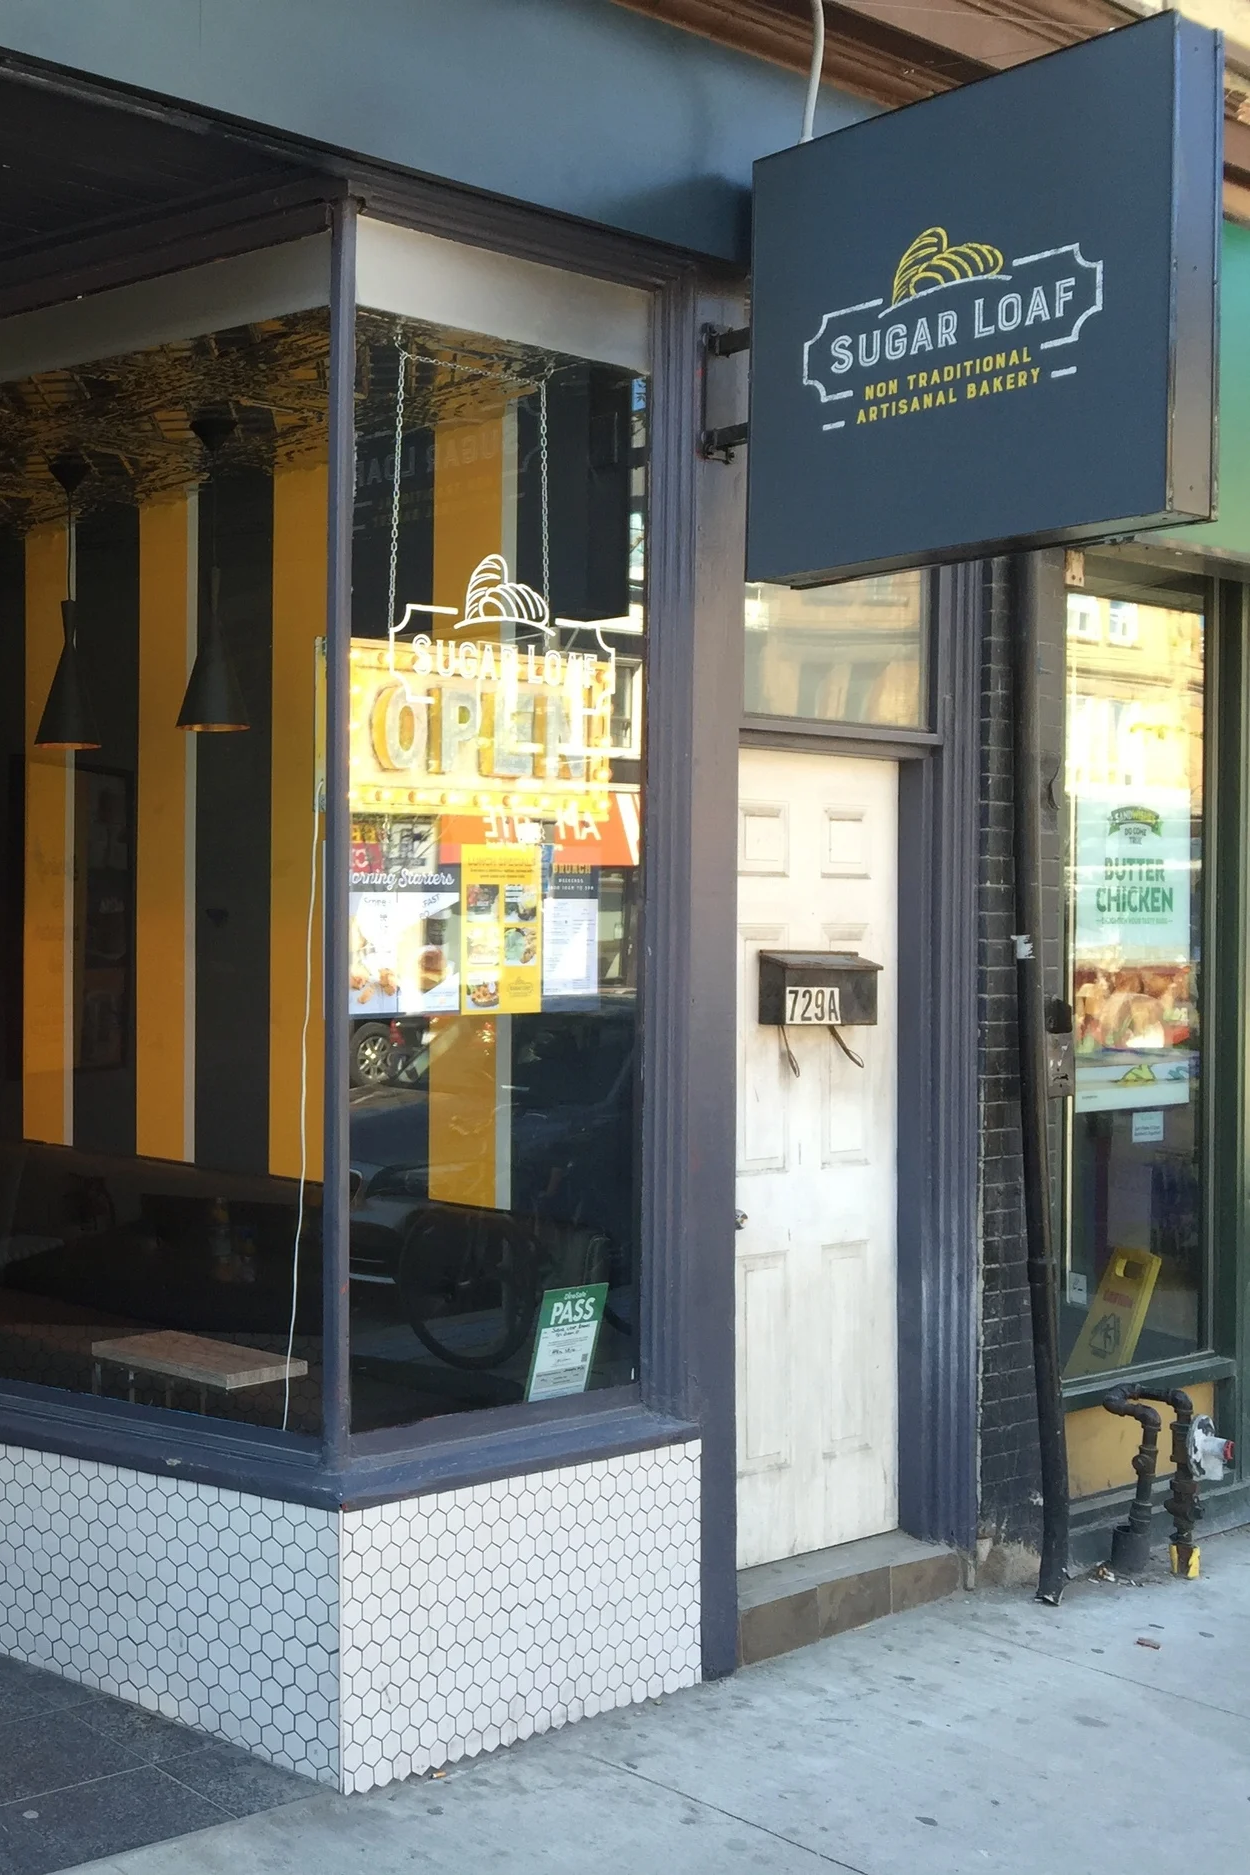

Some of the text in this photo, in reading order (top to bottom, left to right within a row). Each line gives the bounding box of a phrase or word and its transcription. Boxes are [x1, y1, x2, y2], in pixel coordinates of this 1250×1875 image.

[830, 277, 1076, 374] SUGAR LOAF
[864, 346, 1032, 401] NON TRADITIONAL
[856, 367, 1041, 425] ARTISANAL BAKERY
[412, 634, 598, 688] SUGAR LOAF
[371, 684, 586, 779] OPEN
[349, 868, 455, 890] orning Starters
[1105, 857, 1165, 881] BUTTER
[1096, 886, 1173, 912] CHICKEN
[788, 989, 839, 1022] 729A
[550, 1297, 595, 1325] PASS
